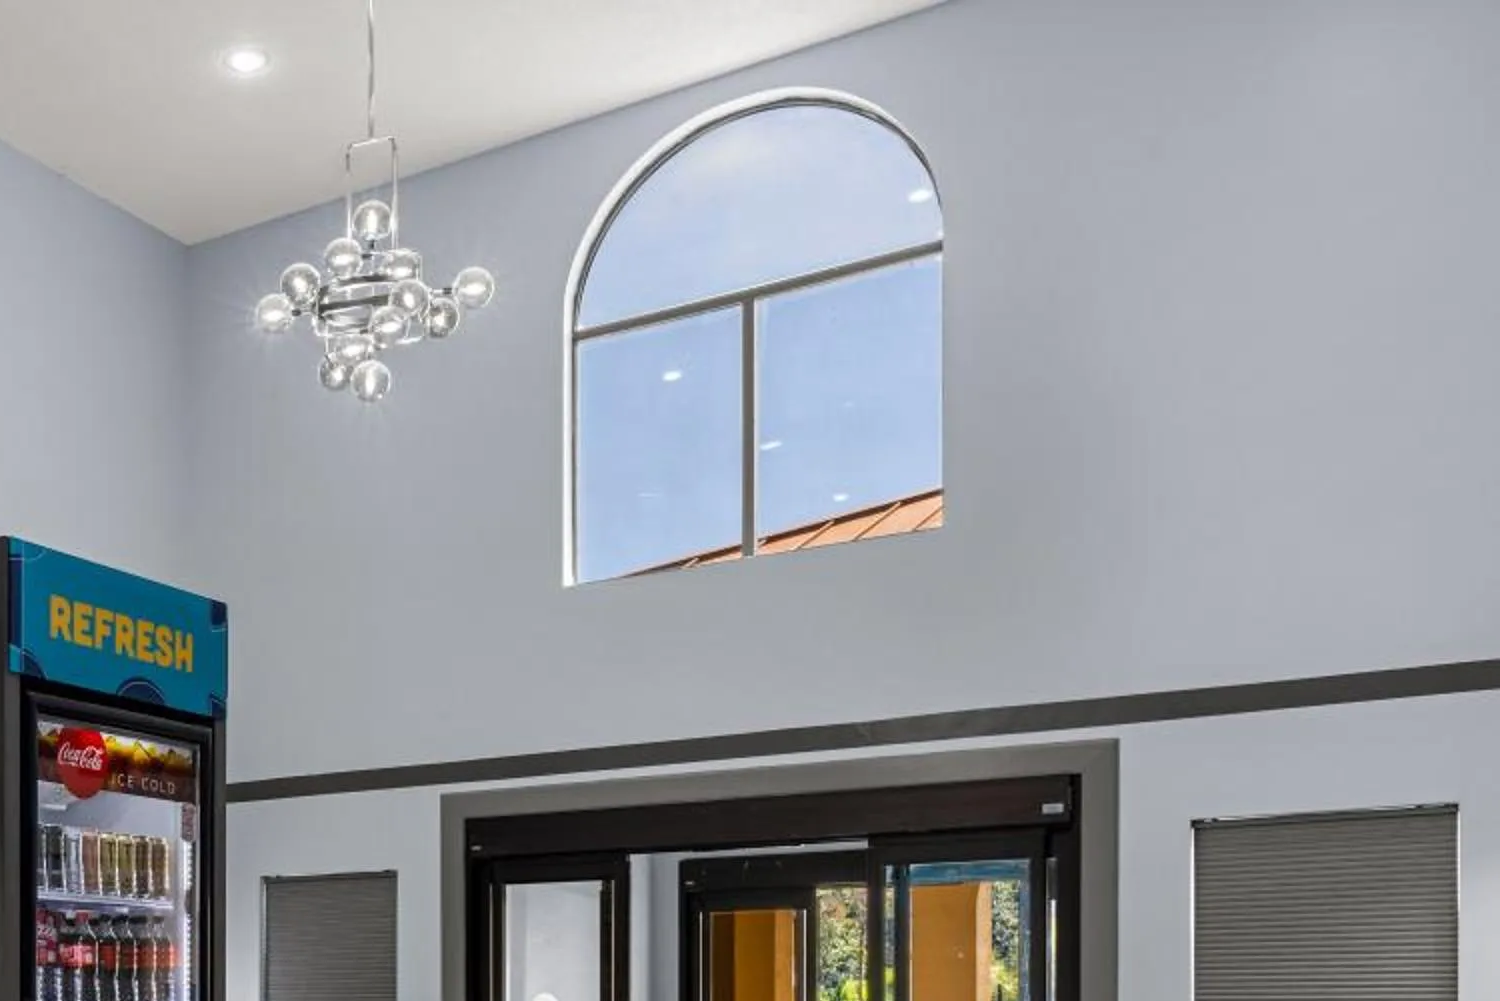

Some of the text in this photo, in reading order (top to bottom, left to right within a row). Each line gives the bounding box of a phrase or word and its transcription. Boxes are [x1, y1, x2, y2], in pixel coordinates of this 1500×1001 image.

[49, 594, 194, 673] REFRESH
[58, 742, 104, 771] Coca-Cola
[112, 772, 177, 796] ICE COLD
